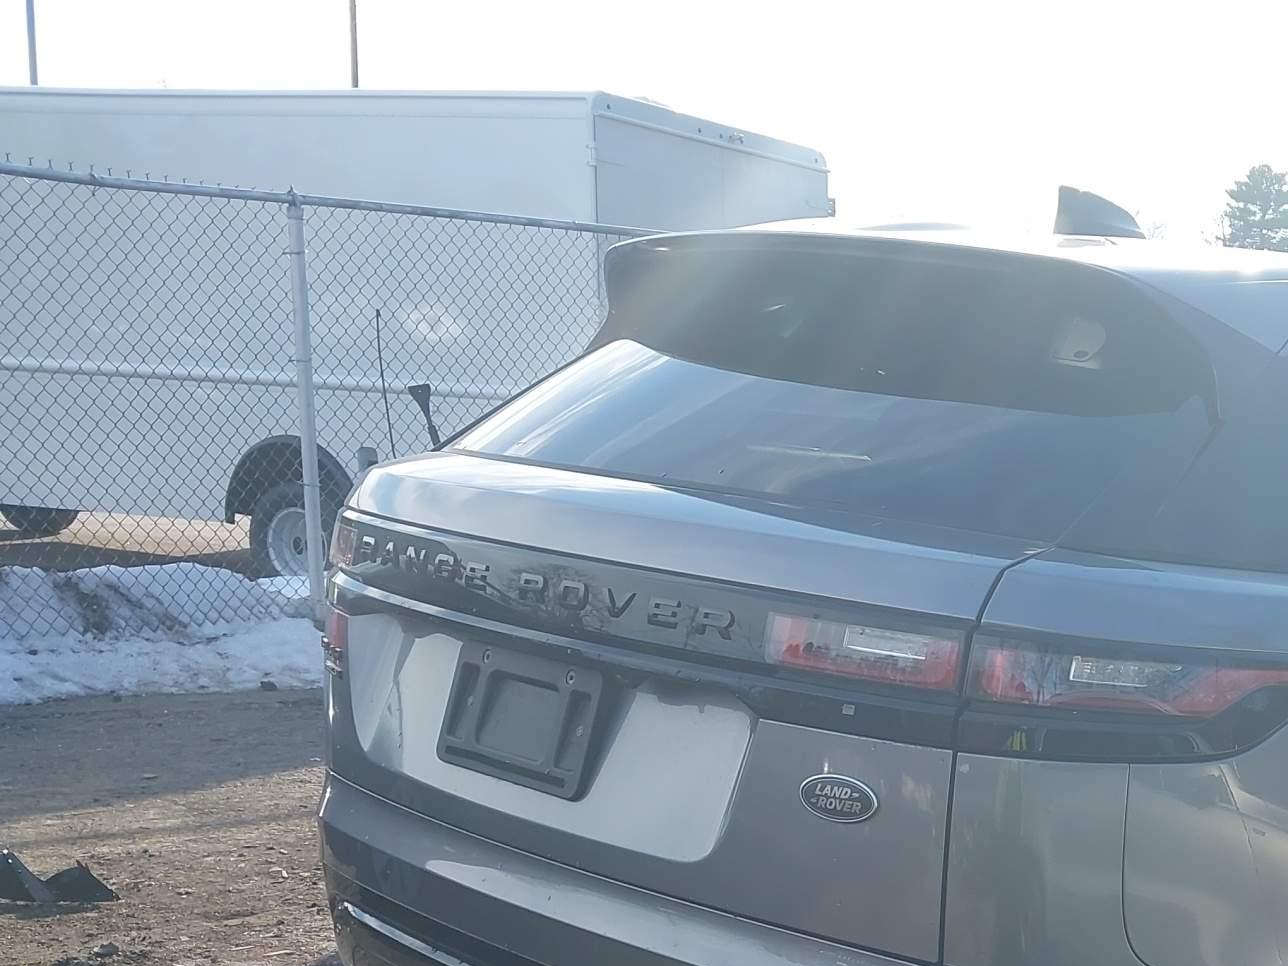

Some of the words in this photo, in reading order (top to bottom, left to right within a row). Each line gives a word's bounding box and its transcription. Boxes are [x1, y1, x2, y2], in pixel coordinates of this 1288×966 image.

[359, 534, 490, 596] RANGE
[517, 571, 736, 641] ROVER
[814, 783, 852, 799] LAND
[816, 796, 862, 814] ROVER
